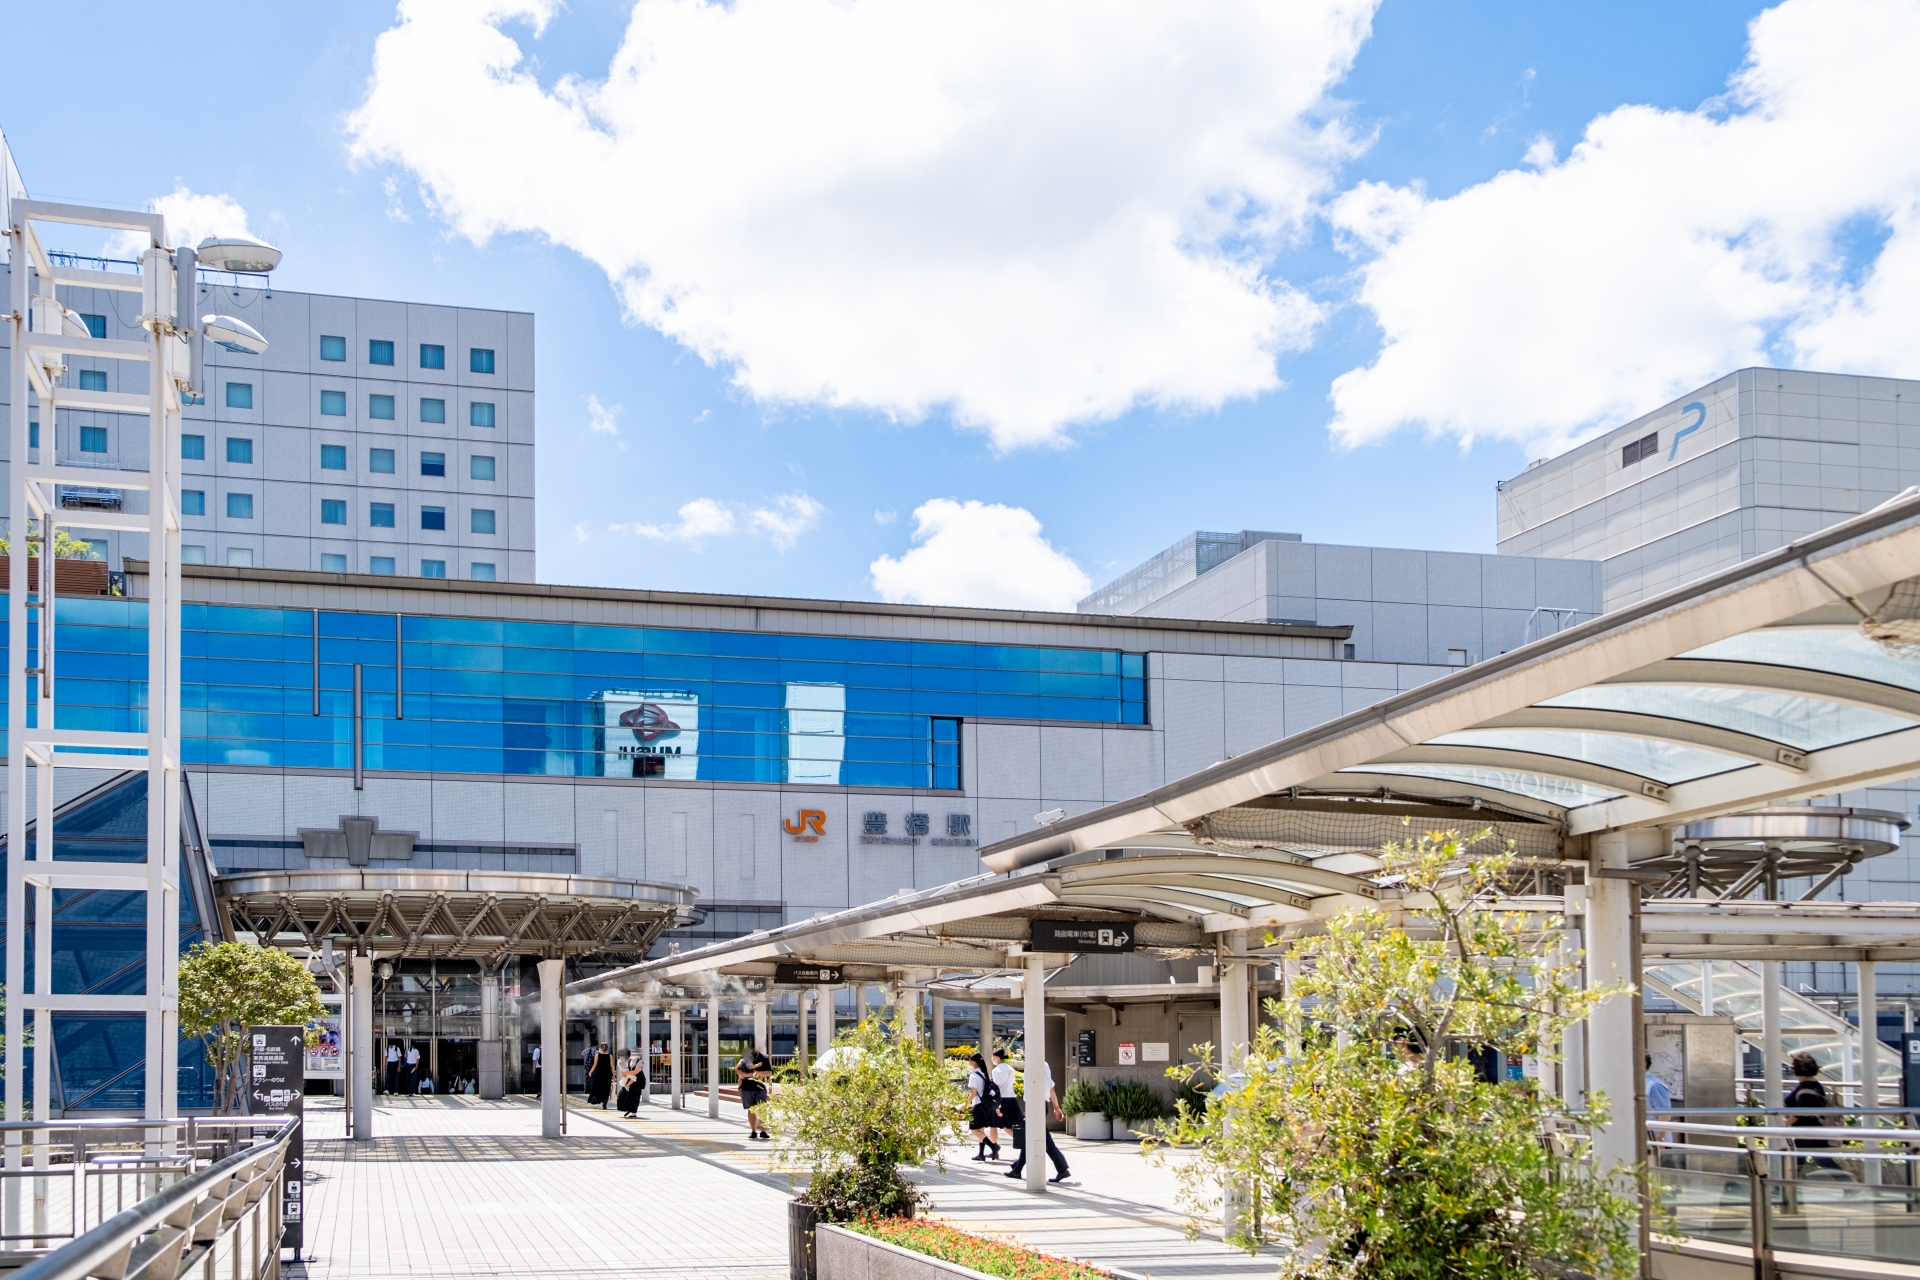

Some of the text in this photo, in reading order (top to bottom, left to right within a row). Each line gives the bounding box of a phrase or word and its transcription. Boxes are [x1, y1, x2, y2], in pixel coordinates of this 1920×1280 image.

[784, 809, 827, 835] JR
[863, 811, 971, 836] 豊橋駅
[860, 836, 979, 846] TOYOHASHI STATION
